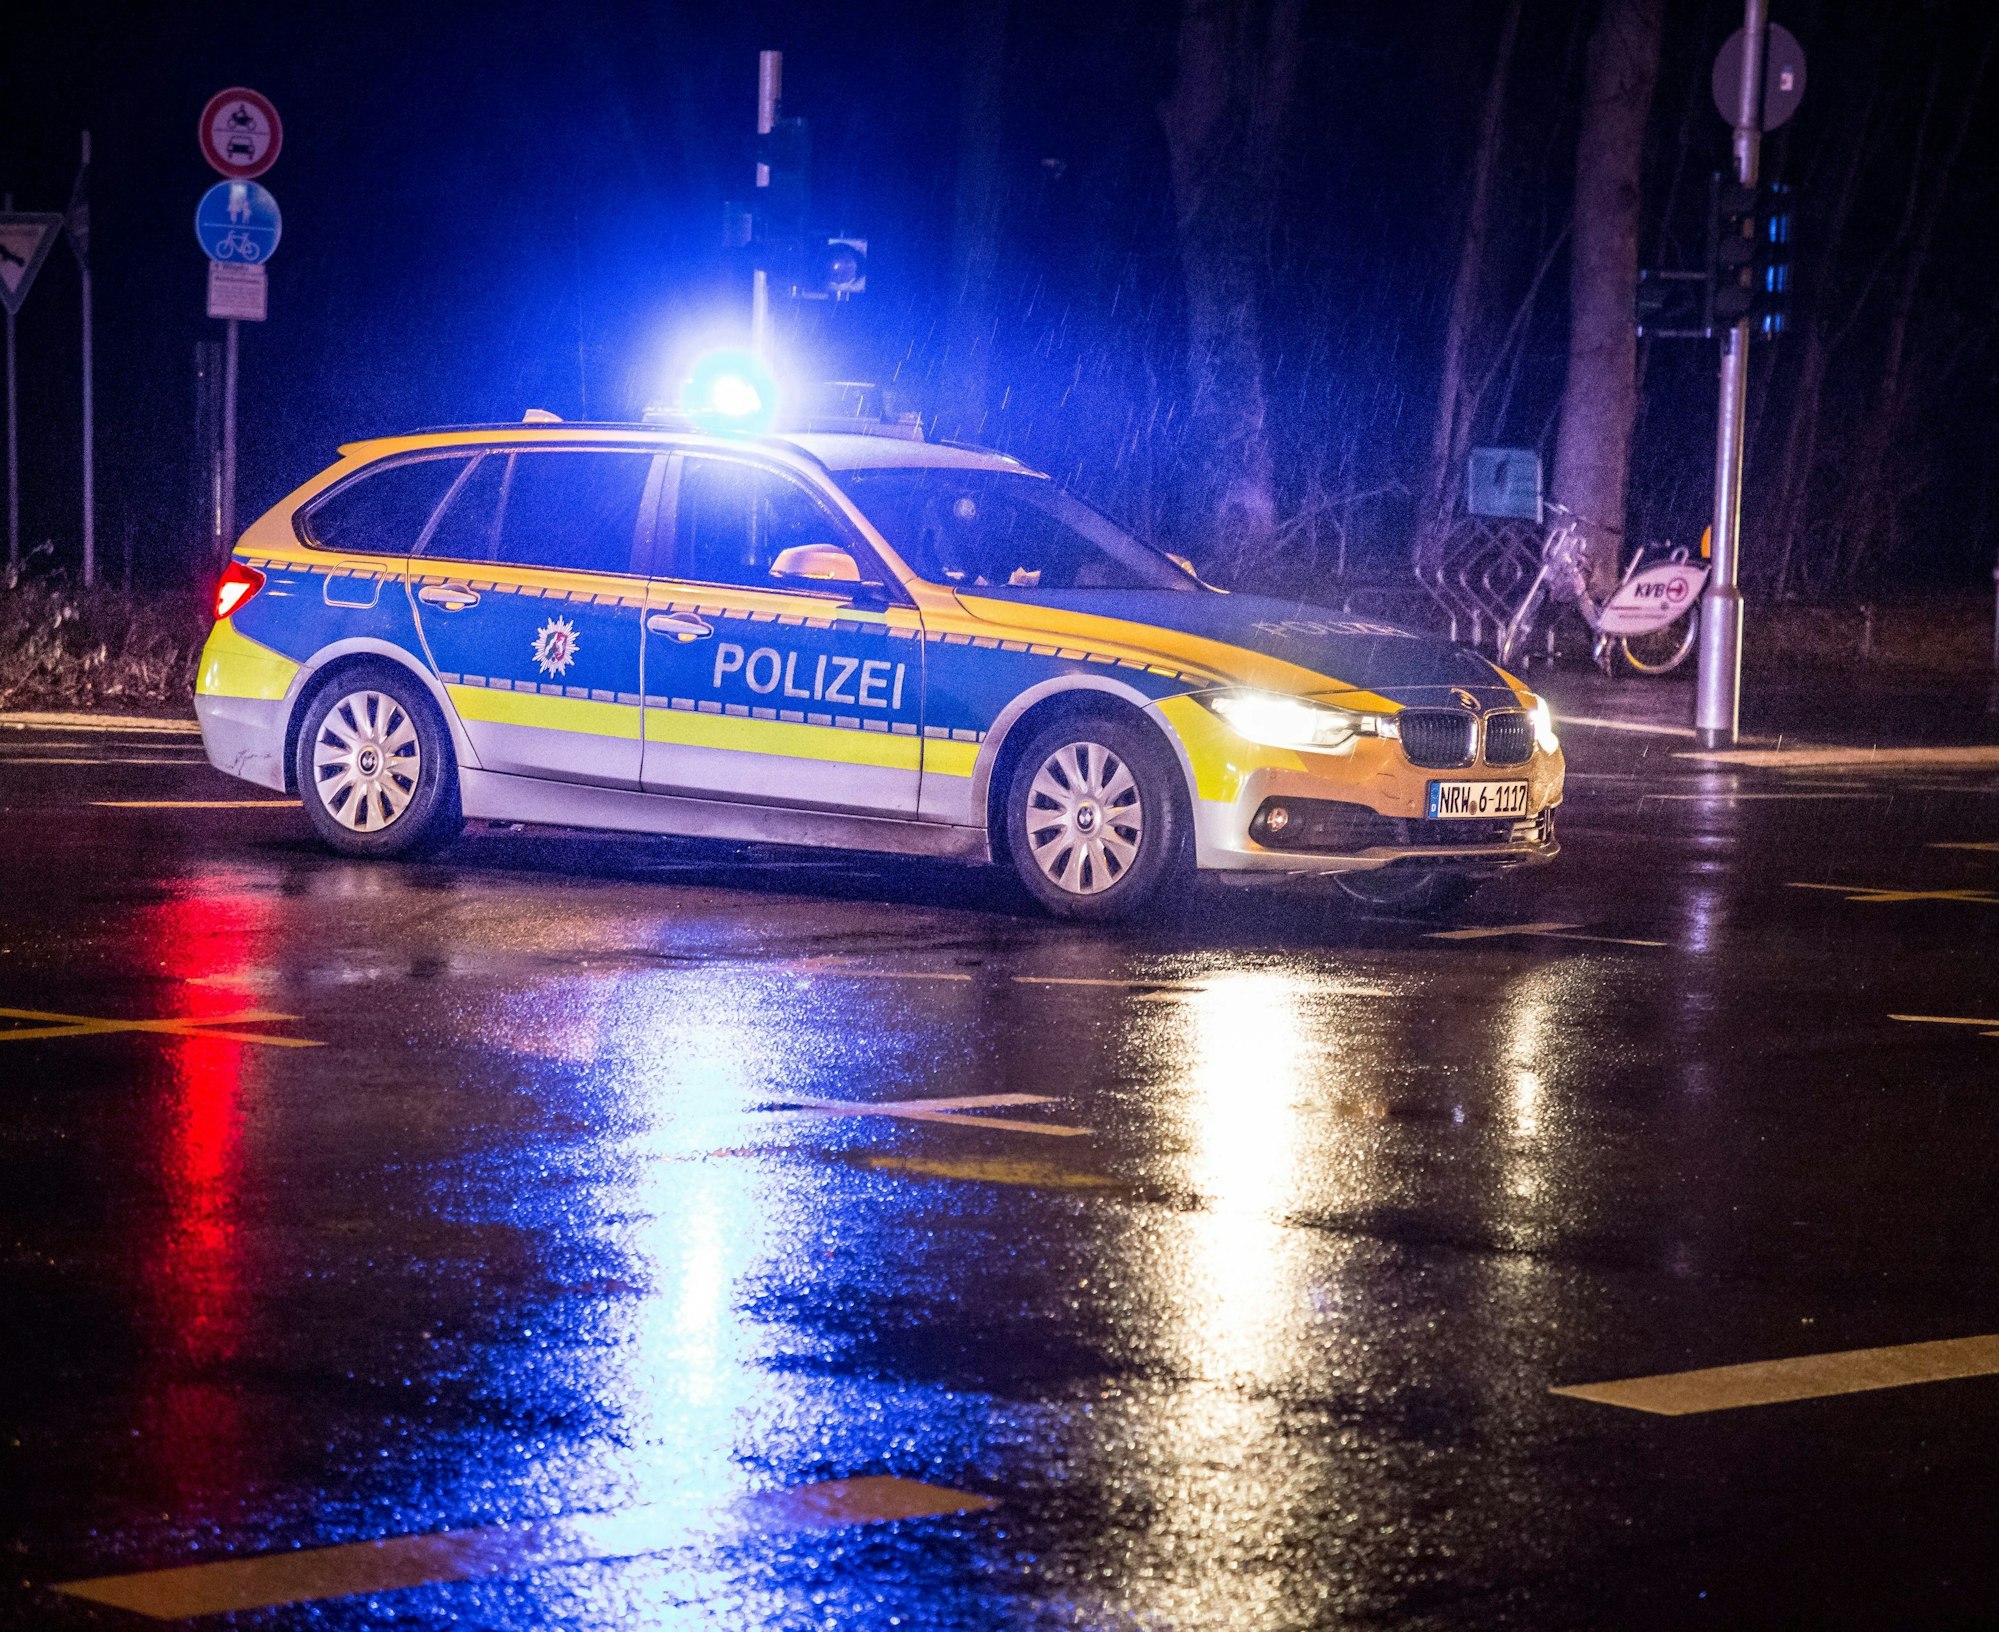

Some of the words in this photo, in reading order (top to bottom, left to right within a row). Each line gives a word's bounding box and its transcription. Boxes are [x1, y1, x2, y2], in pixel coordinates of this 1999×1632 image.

[1634, 583, 1666, 598] KVB
[713, 642, 906, 710] POLIZEI
[1440, 786, 1471, 813] NRW
[1479, 785, 1527, 813] 6-1117
